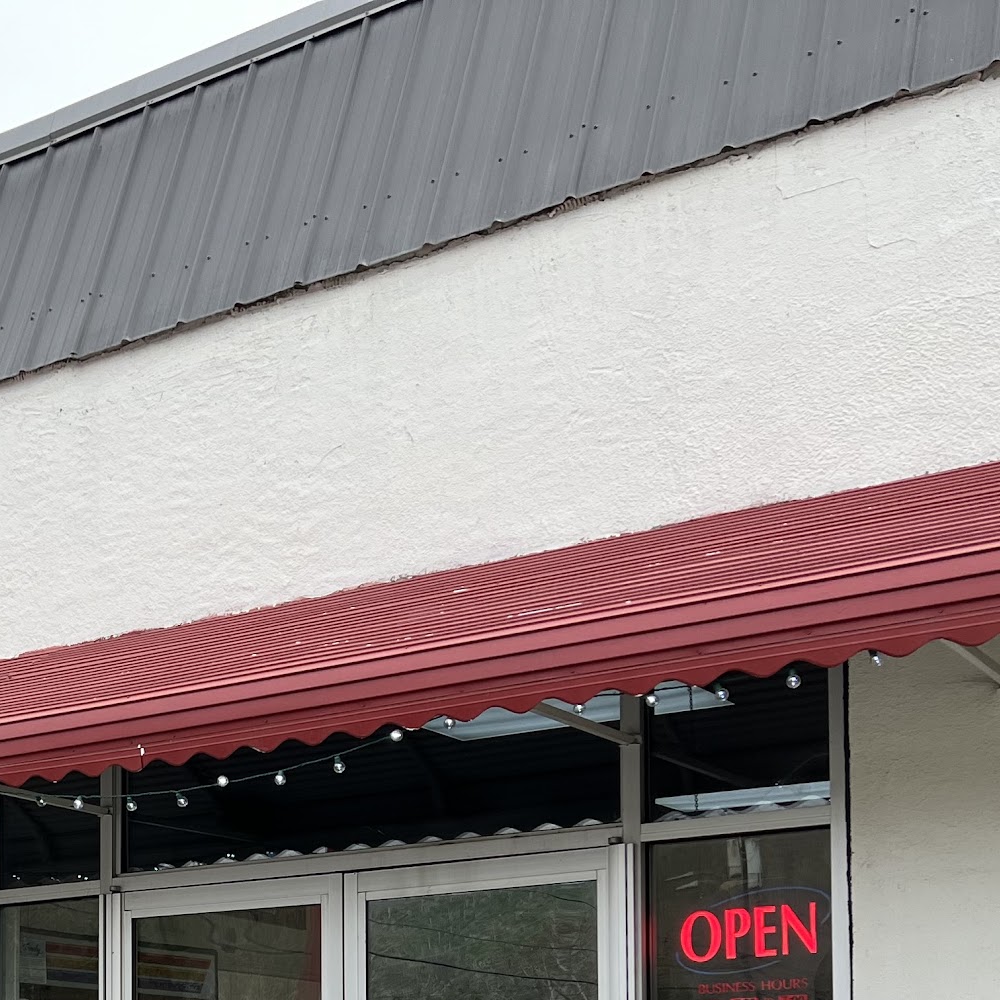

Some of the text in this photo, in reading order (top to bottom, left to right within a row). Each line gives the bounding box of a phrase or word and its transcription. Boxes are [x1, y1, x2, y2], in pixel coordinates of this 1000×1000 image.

[680, 902, 818, 963] OPEN
[698, 977, 809, 994] BUSINESS HOURS
